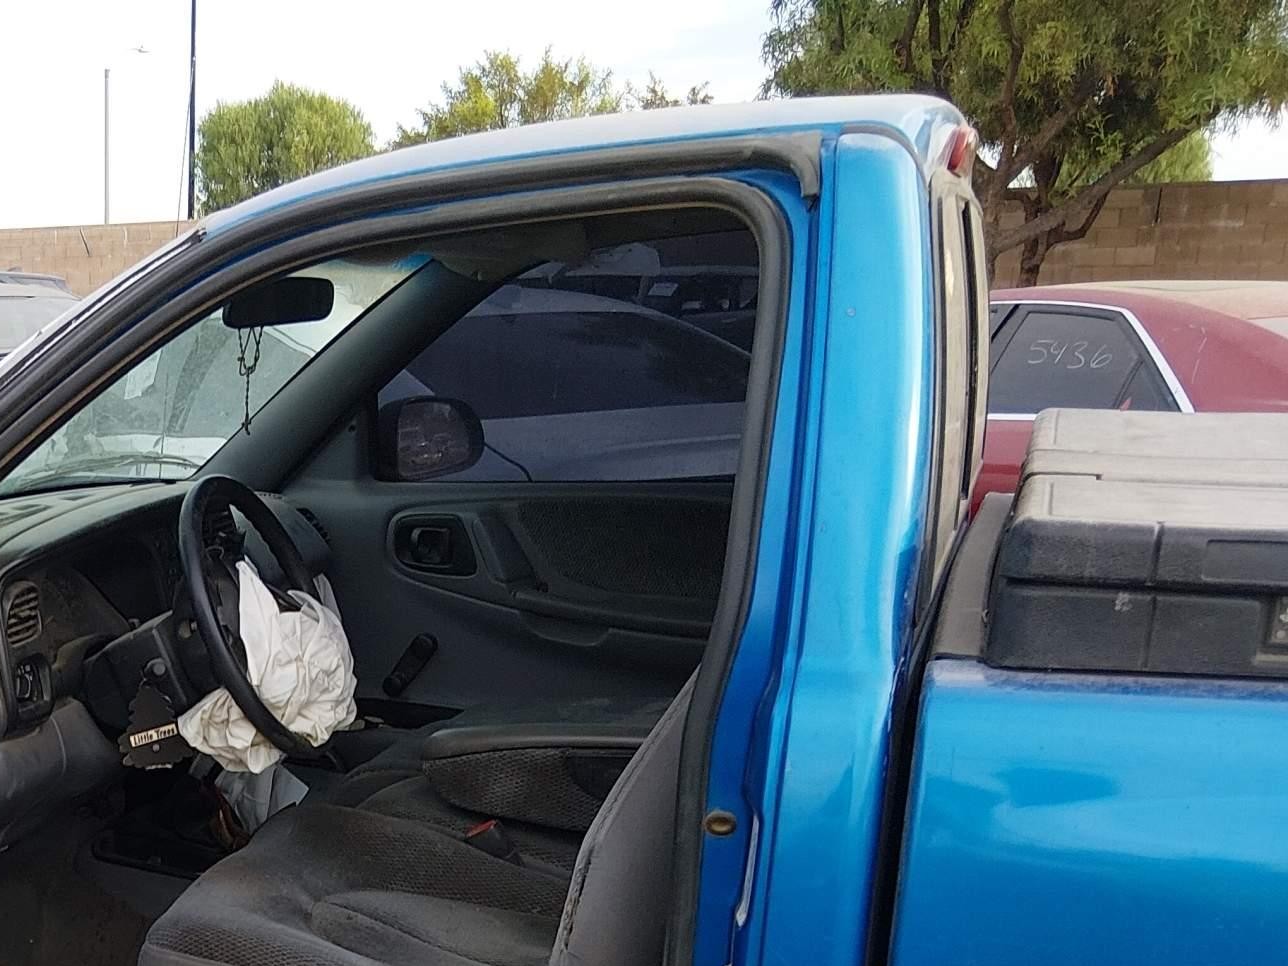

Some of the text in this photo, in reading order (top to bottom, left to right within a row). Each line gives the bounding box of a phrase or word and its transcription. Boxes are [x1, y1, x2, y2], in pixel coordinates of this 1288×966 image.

[1027, 339, 1113, 369] 5436
[133, 727, 175, 745] Little Trees
